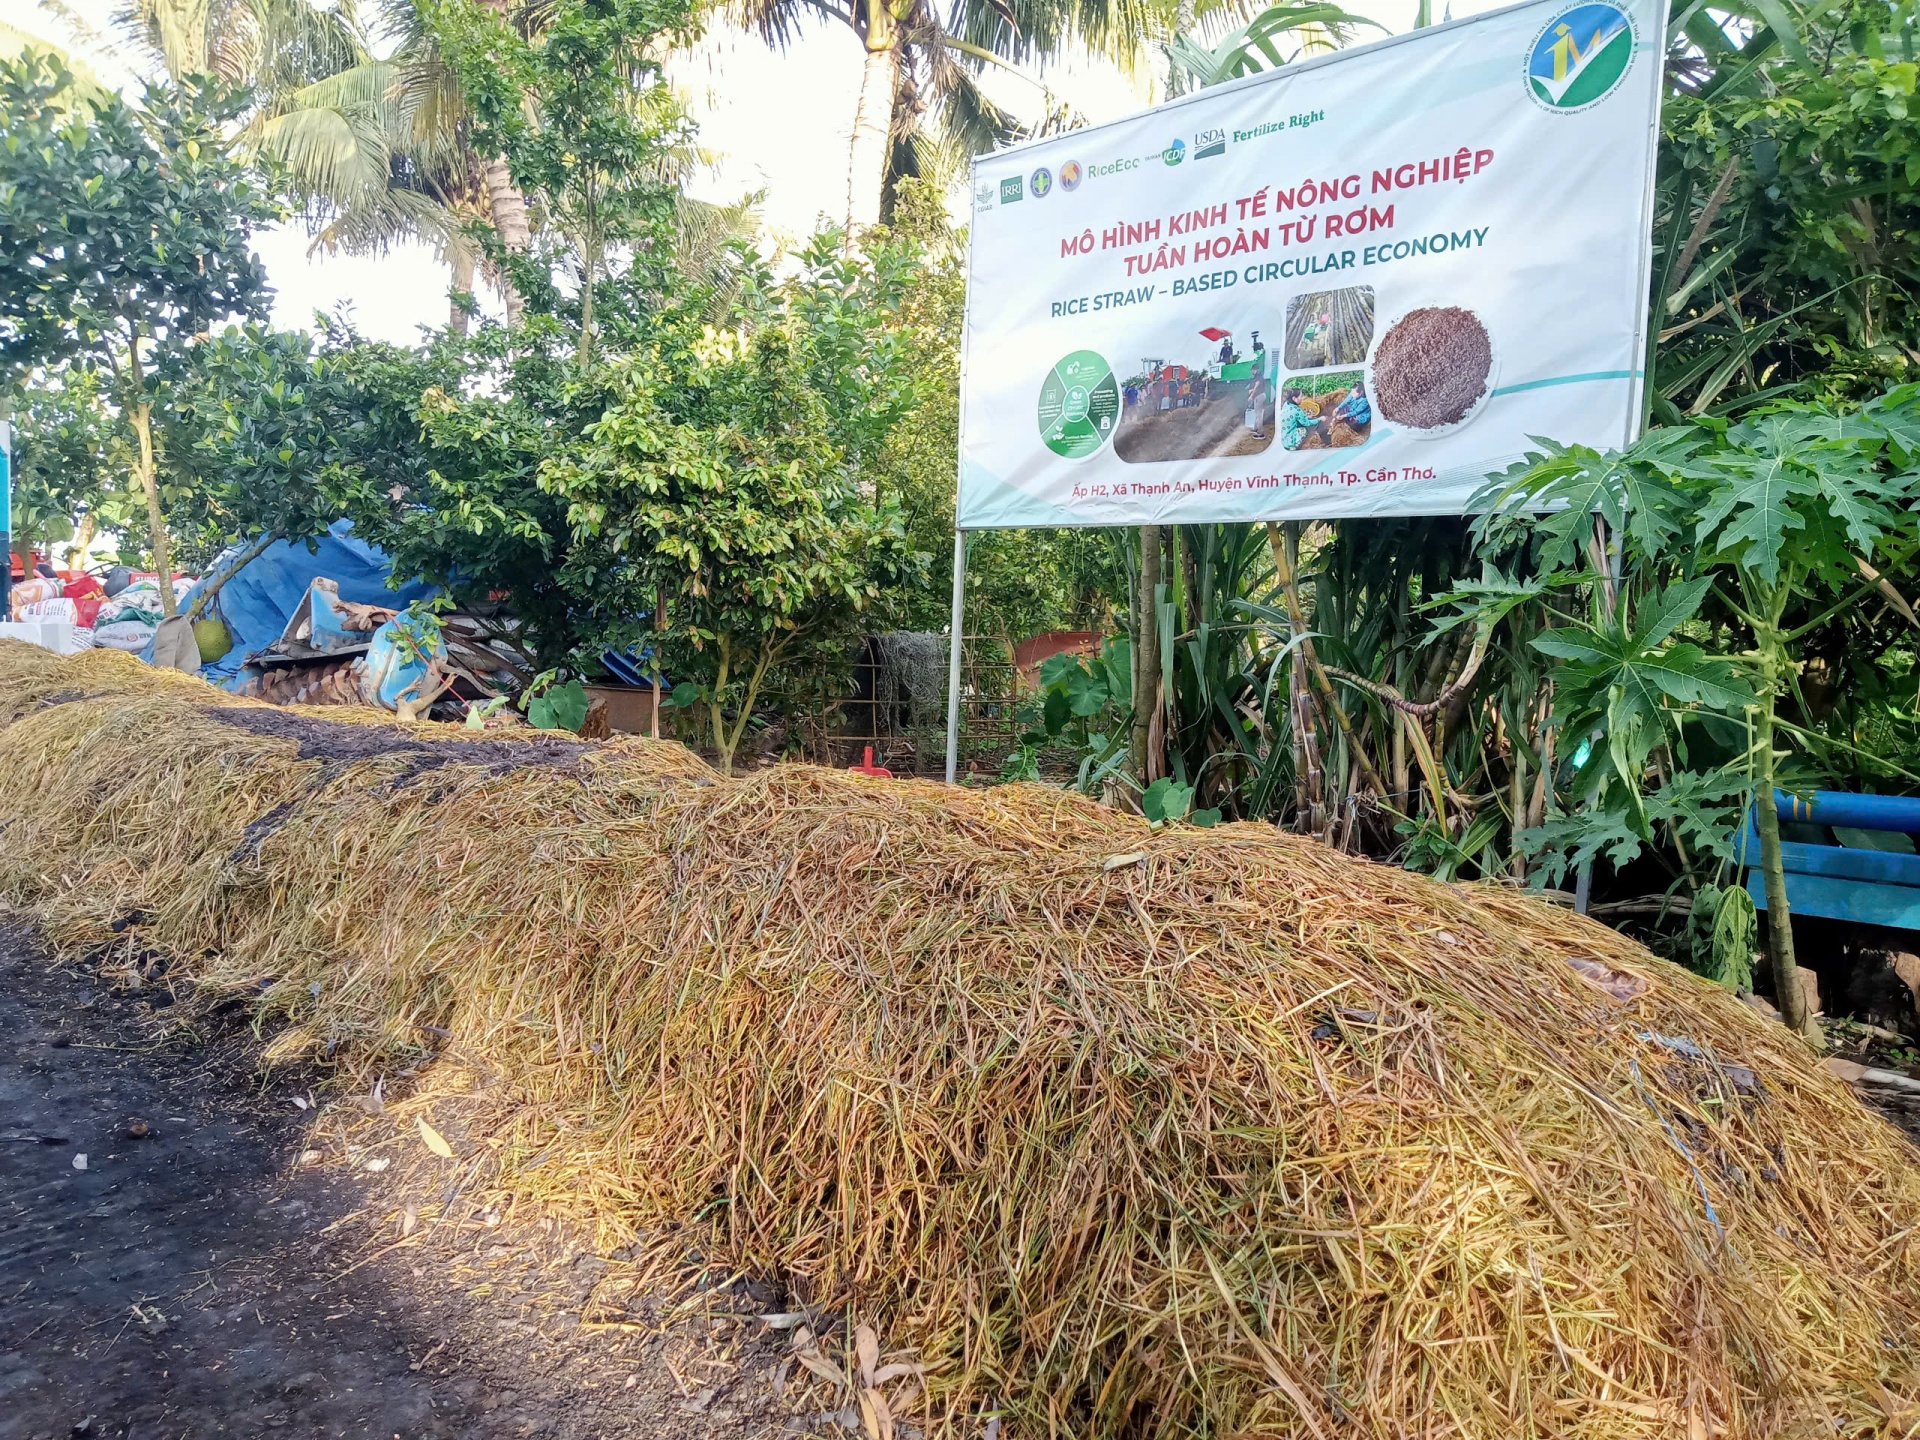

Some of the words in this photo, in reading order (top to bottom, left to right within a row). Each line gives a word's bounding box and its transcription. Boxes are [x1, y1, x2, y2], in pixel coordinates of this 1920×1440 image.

[1195, 128, 1225, 145] USDA
[1232, 120, 1285, 143] Fertilize
[1289, 109, 1325, 128] Right
[1162, 149, 1185, 162] ICDF
[1002, 183, 1022, 197] IRRI
[1060, 228, 1095, 259] MÔ
[1102, 218, 1161, 250] HÌNH
[1168, 203, 1227, 237] KINH
[1236, 185, 1271, 221] TẾ
[1276, 175, 1361, 213] NÔNG
[1371, 147, 1495, 194] NGHIỆP
[1124, 242, 1186, 277] TUẦN
[1193, 228, 1270, 263] HOÀN
[1279, 214, 1317, 247] TỪ
[1325, 204, 1395, 239] RƠM
[1051, 297, 1089, 318] RICE
[1093, 285, 1155, 311] STRAW
[1172, 269, 1238, 297] BASED
[1244, 250, 1356, 284] CIRCULAR
[1363, 226, 1490, 266] ECONOMY
[1072, 482, 1088, 499] Ấp
[1091, 485, 1109, 498] H2,
[1112, 484, 1127, 496] Xã
[1131, 482, 1170, 497] Thạnh
[1173, 481, 1195, 493] An,
[1198, 477, 1242, 492] Huyện
[1246, 475, 1279, 489] Vĩnh
[1283, 472, 1333, 489] Thạnh,
[1338, 471, 1361, 486] Tp.
[1366, 467, 1397, 483] Cần
[1402, 466, 1437, 480] Thơ.
